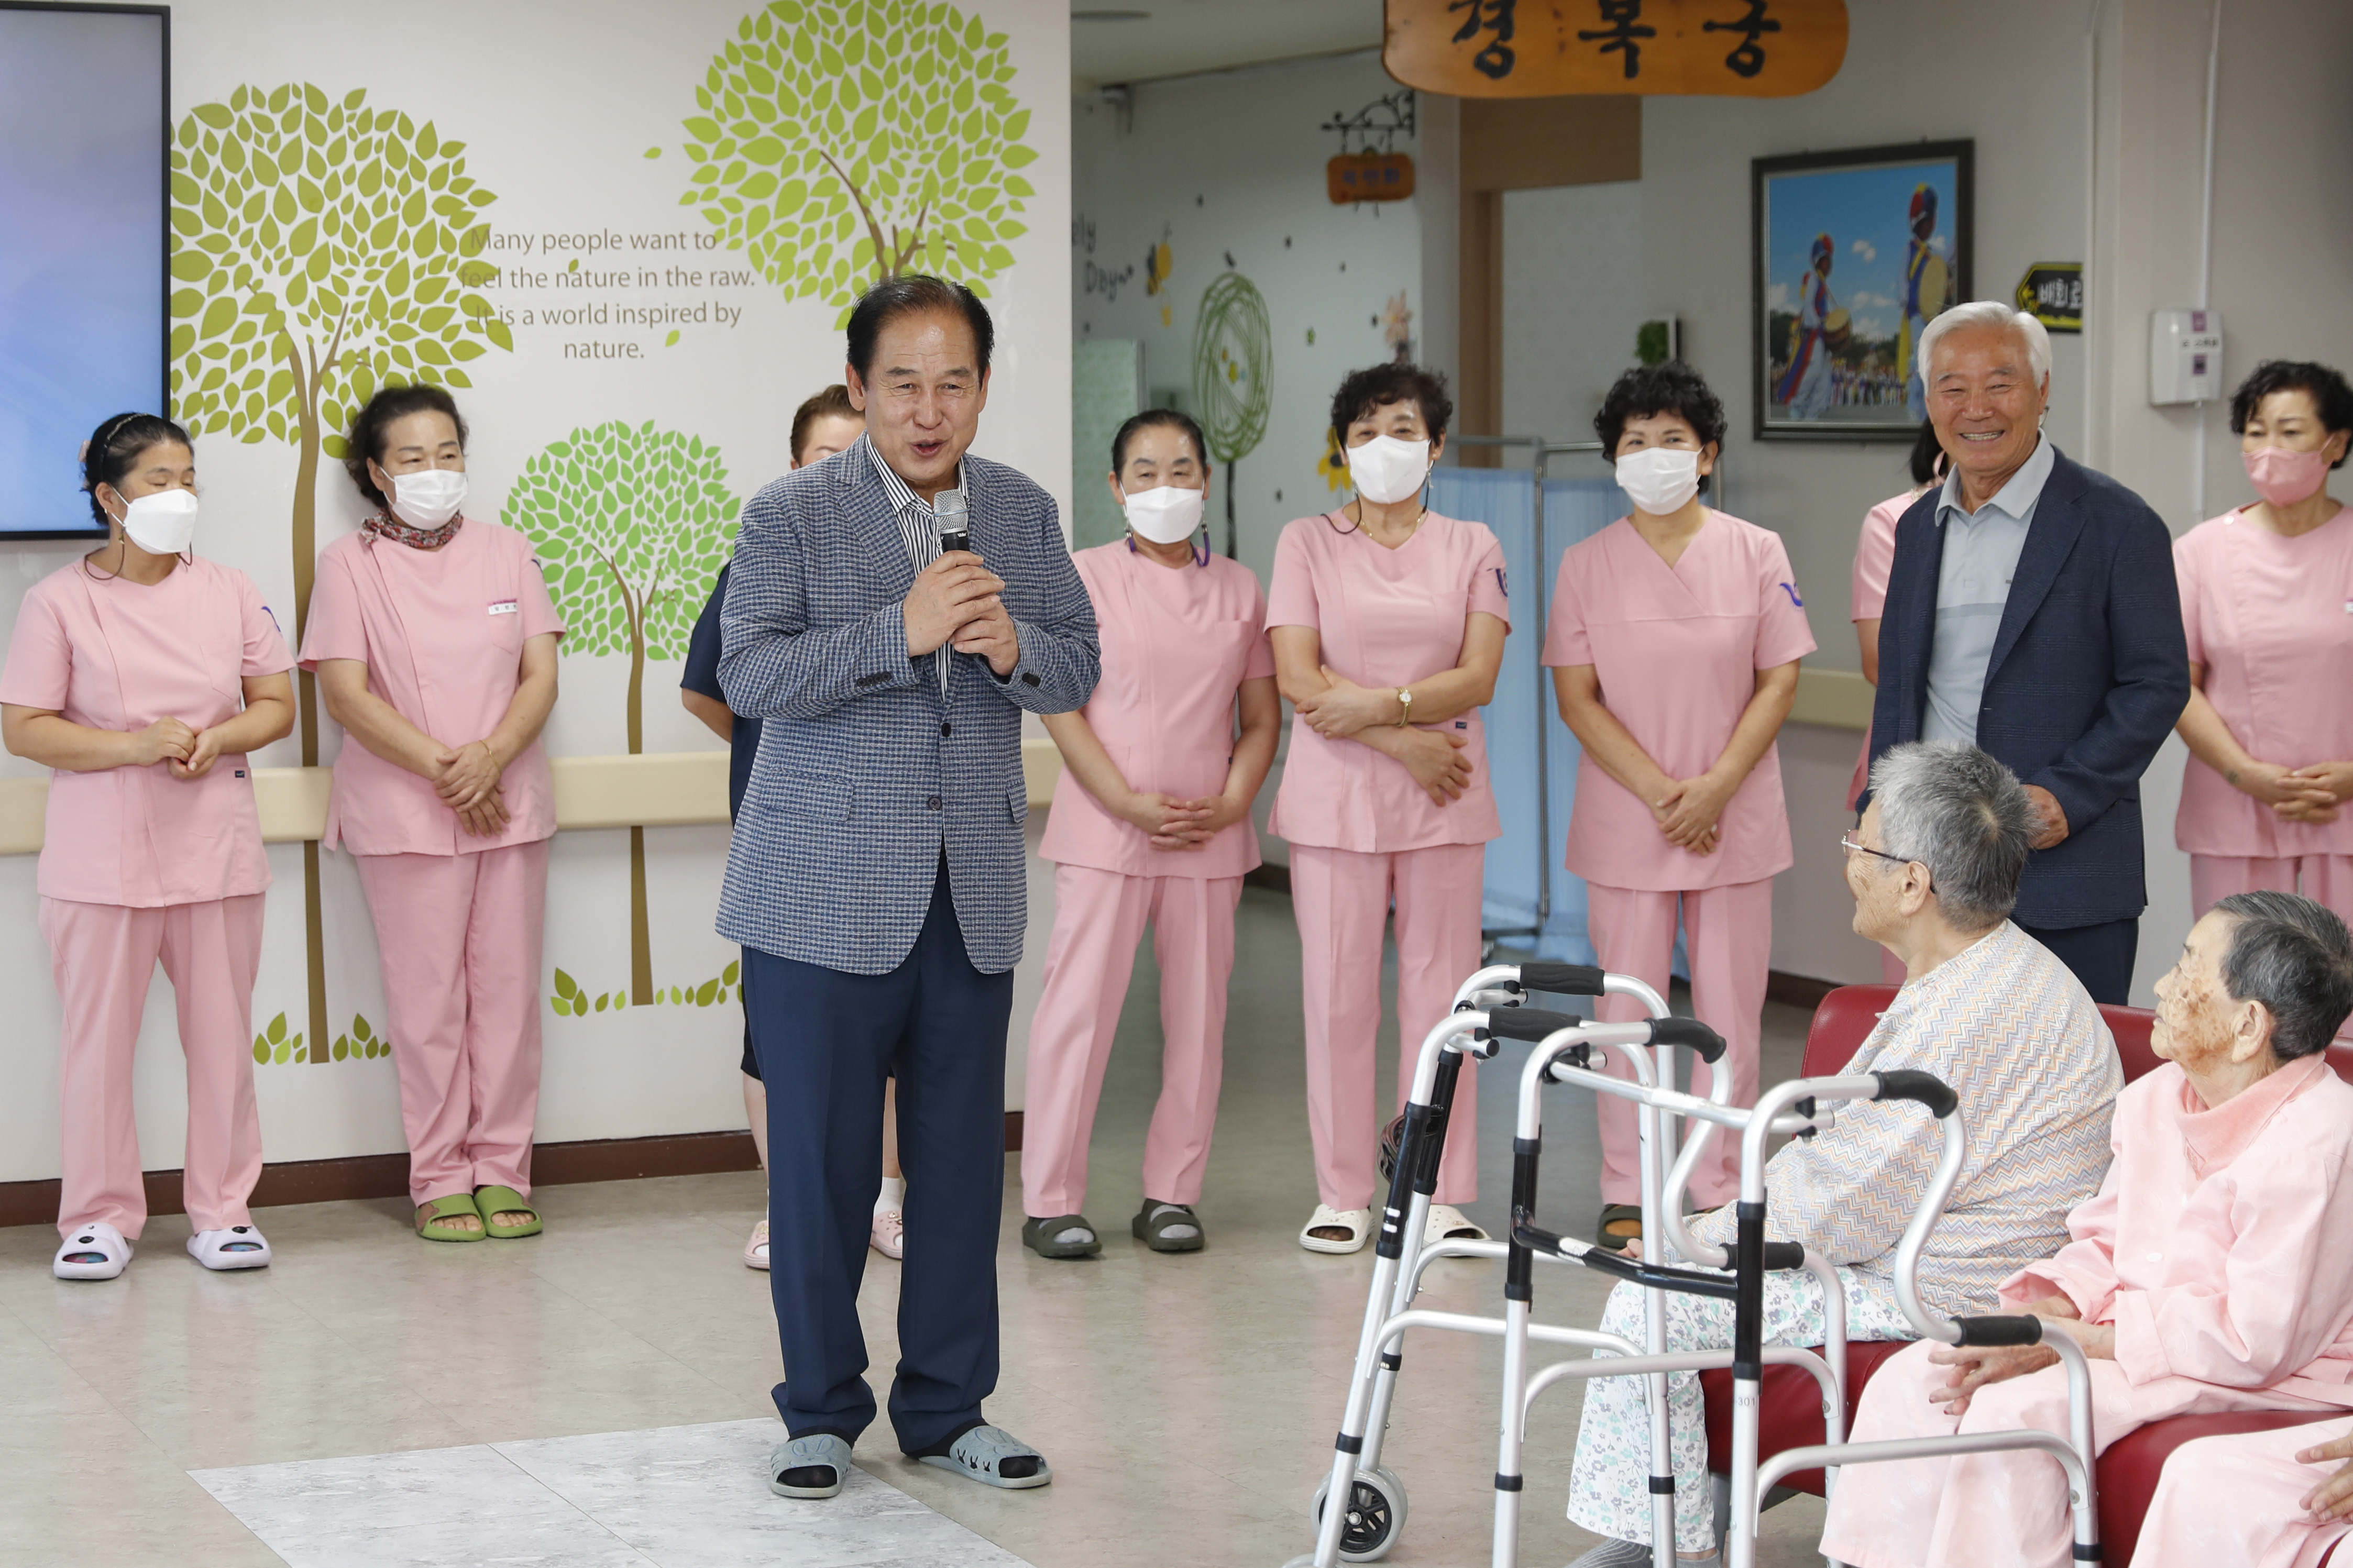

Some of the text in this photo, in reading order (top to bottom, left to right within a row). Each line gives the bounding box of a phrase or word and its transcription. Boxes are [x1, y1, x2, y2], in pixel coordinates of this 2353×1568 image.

[471, 227, 717, 256] Many people want to
[460, 264, 755, 288] feel the nature in the raw.
[476, 301, 742, 329] It is a world inspired by
[564, 340, 644, 359] nature.
